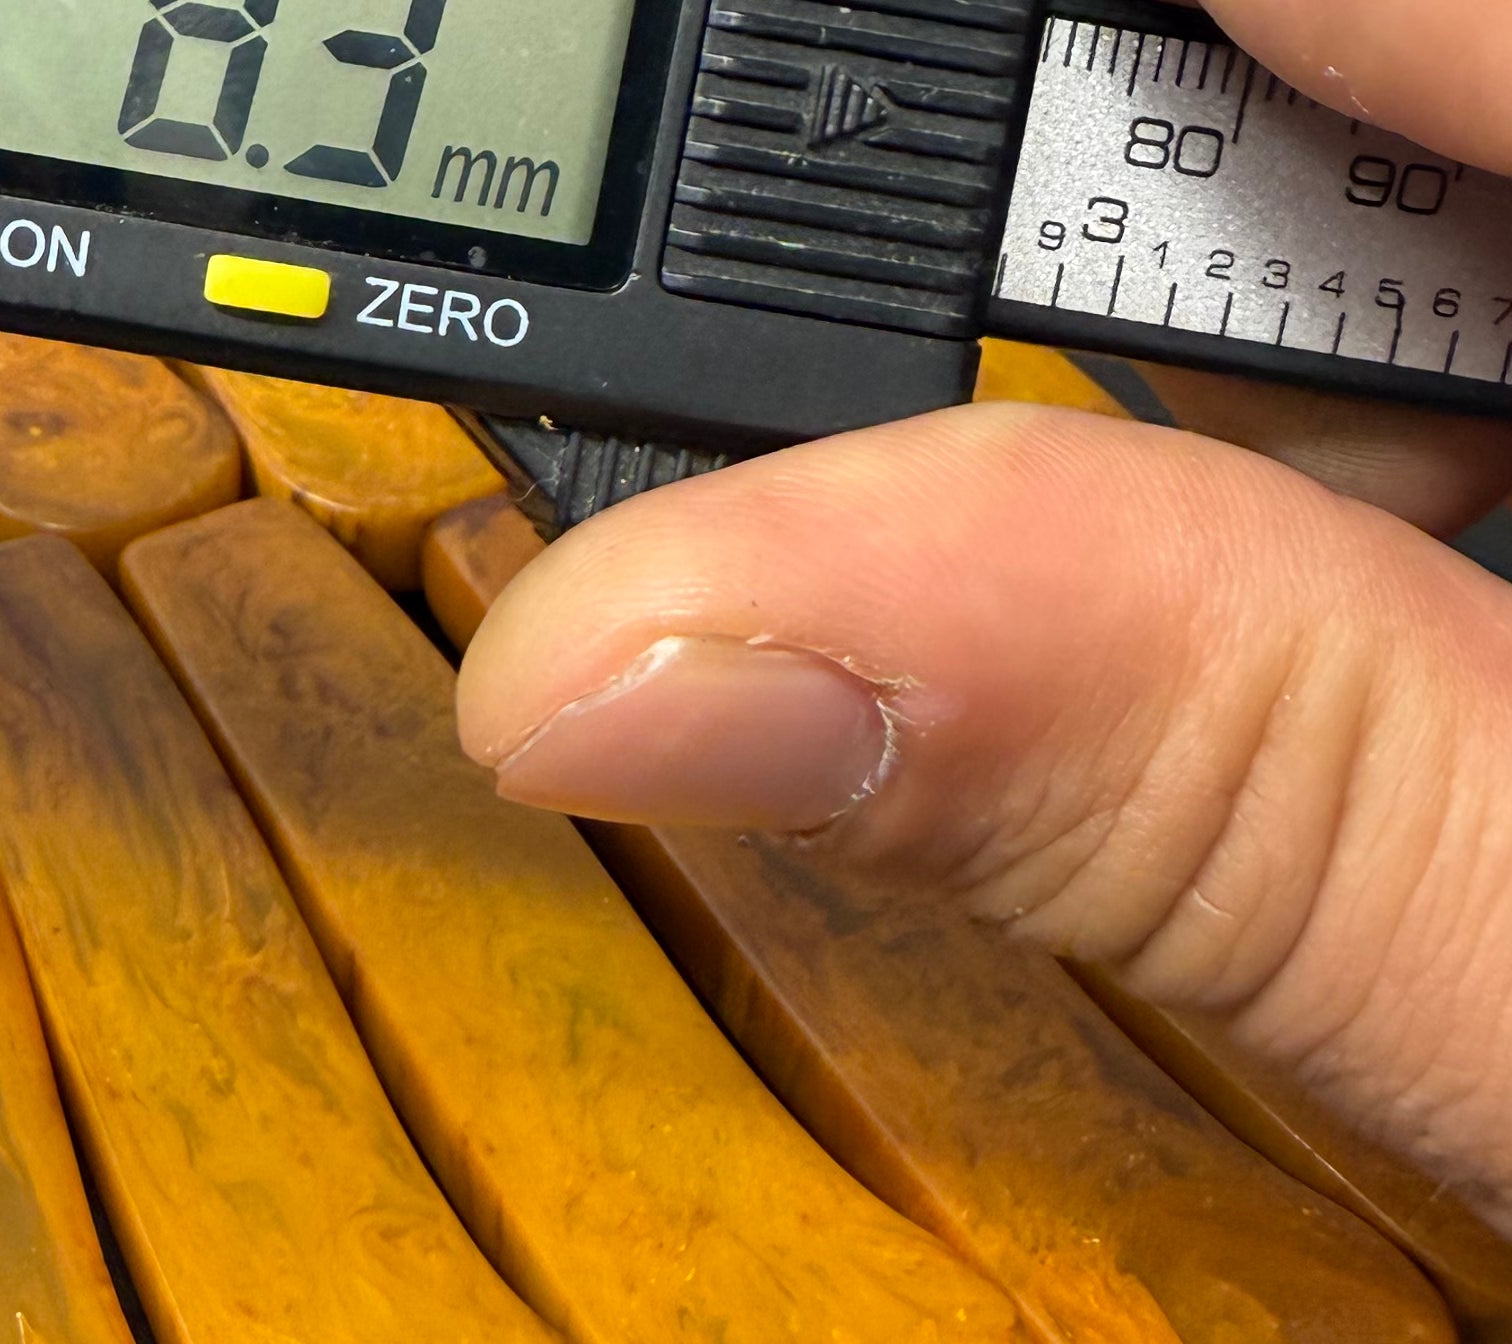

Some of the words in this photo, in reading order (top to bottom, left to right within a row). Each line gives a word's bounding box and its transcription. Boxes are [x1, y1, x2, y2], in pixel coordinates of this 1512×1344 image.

[432, 142, 561, 219] mm
[1124, 116, 1225, 179] 80
[1345, 155, 1449, 216] 90
[0, 218, 90, 278] ON
[1037, 220, 1067, 252] 9
[1081, 196, 1130, 245] 3
[1152, 240, 1170, 269] 1
[1204, 249, 1235, 280] 2
[1263, 260, 1291, 289] 3
[1318, 270, 1346, 298] 4
[1375, 278, 1405, 310] 5
[1432, 287, 1463, 318] 6
[1492, 296, 1512, 326] 7
[355, 277, 530, 348] ZERO
